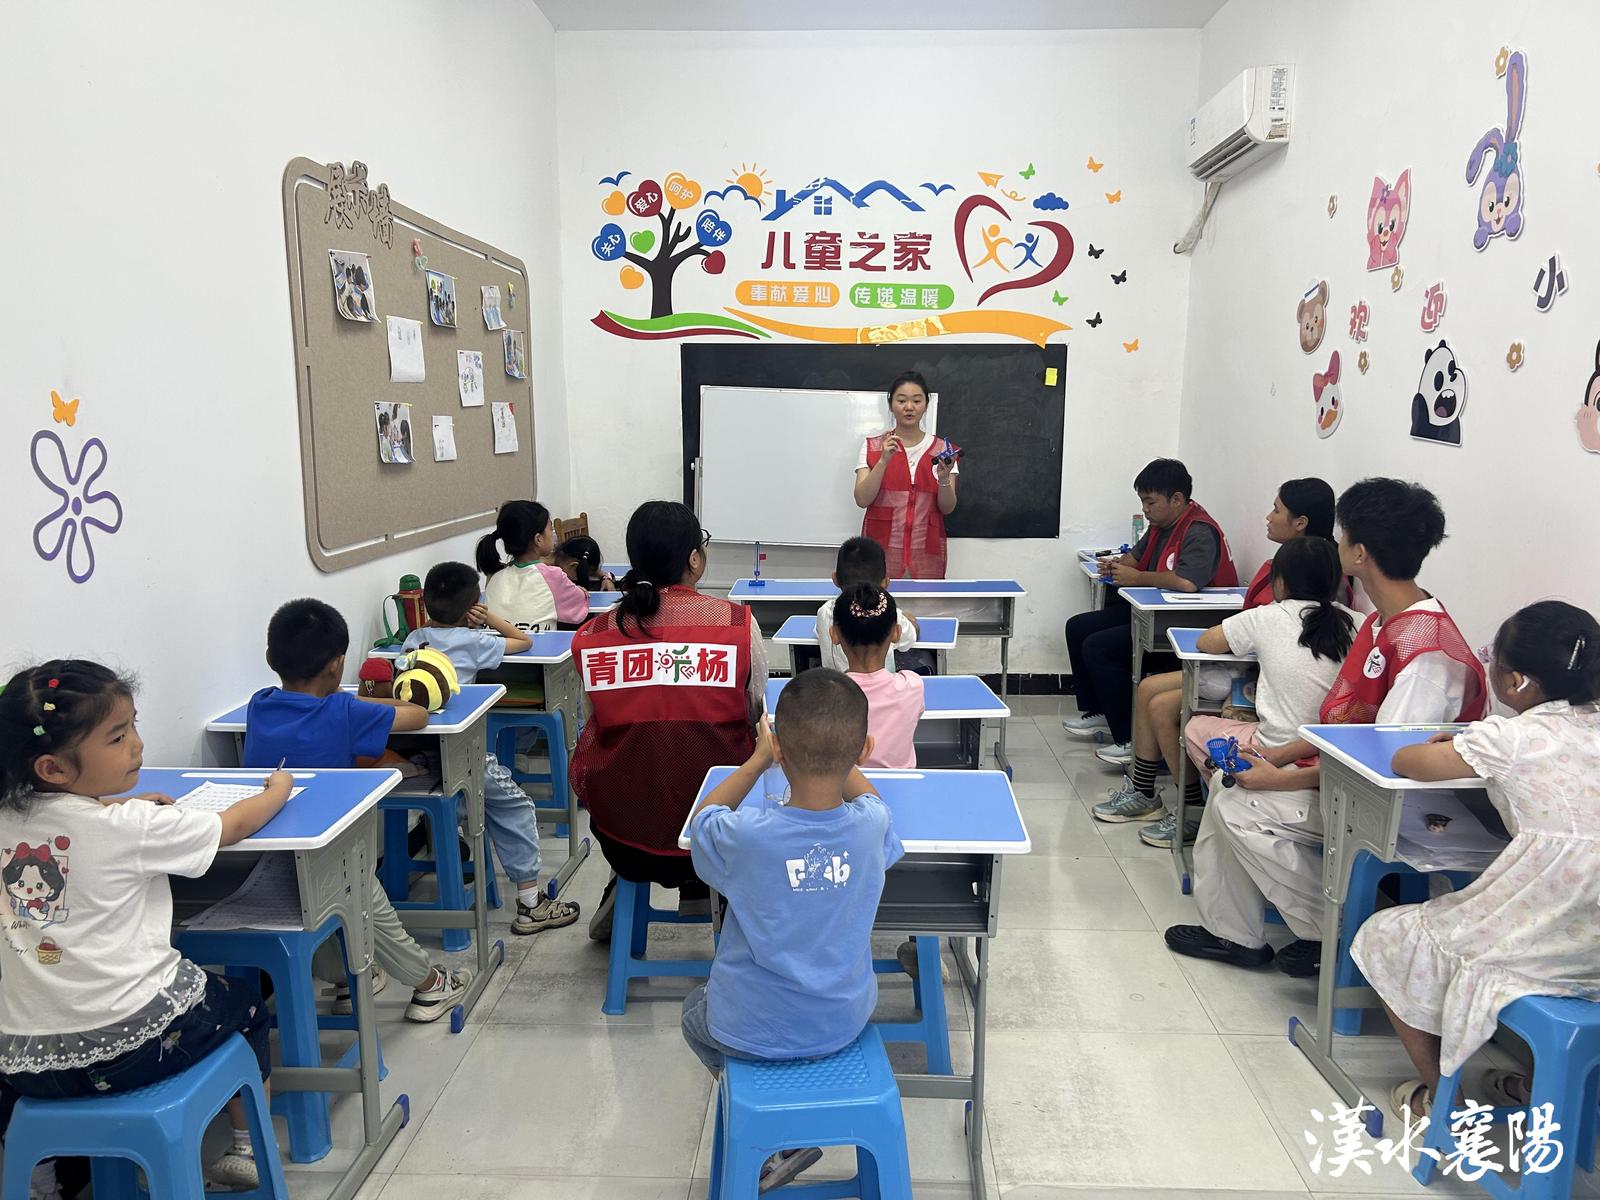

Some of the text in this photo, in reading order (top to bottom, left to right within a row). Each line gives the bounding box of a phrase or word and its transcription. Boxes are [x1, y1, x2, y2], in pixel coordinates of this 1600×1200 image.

[634, 192, 659, 213] 爱心
[669, 182, 695, 201] 呵护
[324, 160, 394, 249] 展示墙
[701, 217, 727, 242] 陪伴
[601, 234, 621, 257] 关心
[761, 230, 932, 272] 儿童之家
[751, 284, 832, 303] 奉献爱心
[854, 286, 939, 307] 传递温暖
